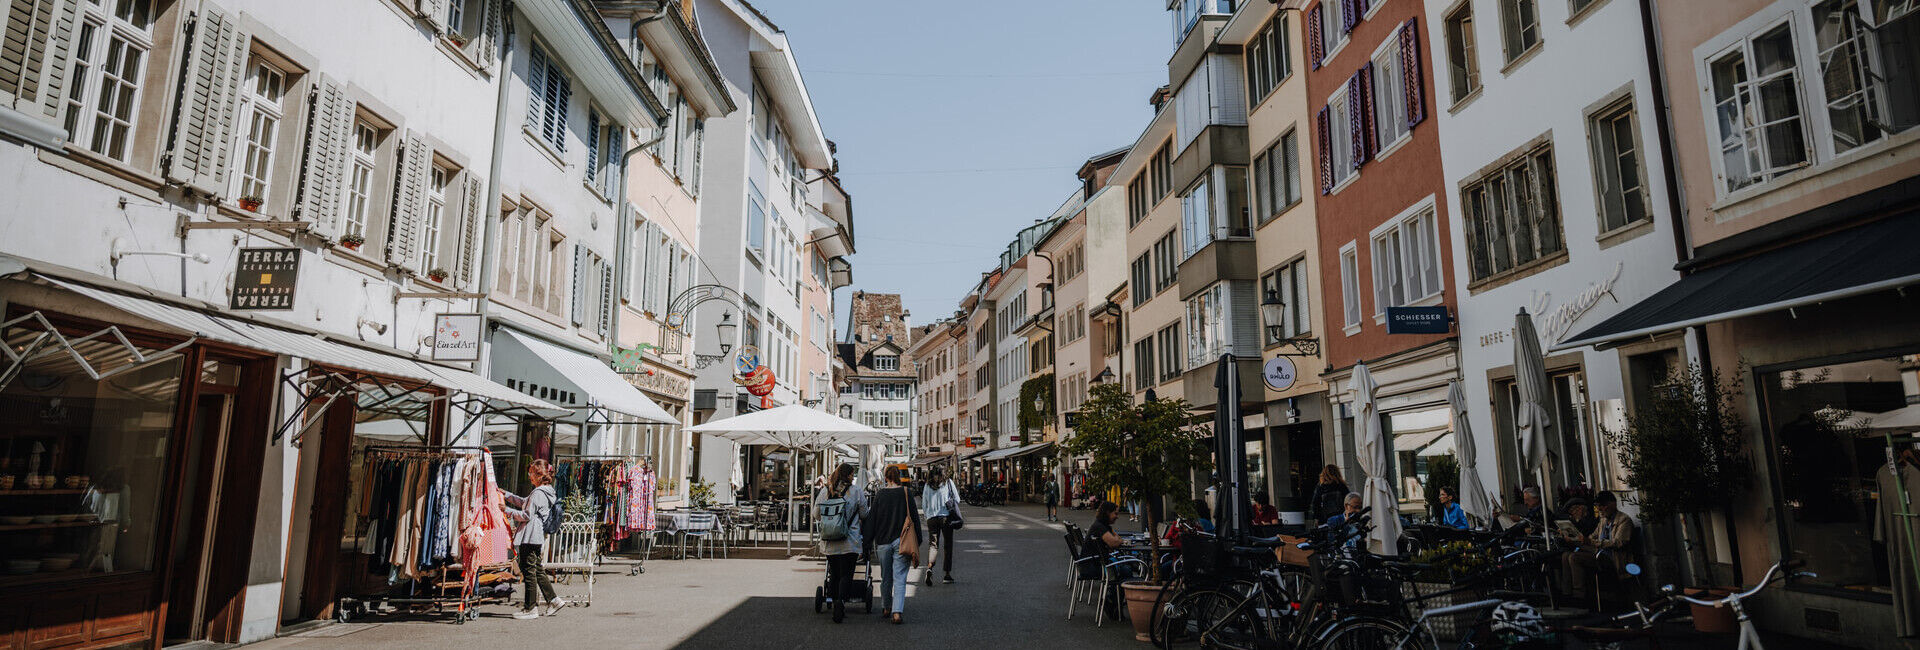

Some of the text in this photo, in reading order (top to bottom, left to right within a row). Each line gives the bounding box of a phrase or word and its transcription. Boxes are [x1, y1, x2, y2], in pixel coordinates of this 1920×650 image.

[243, 251, 295, 262] TERRA
[237, 295, 289, 306] TERRA
[436, 340, 477, 349] EinzelArt
